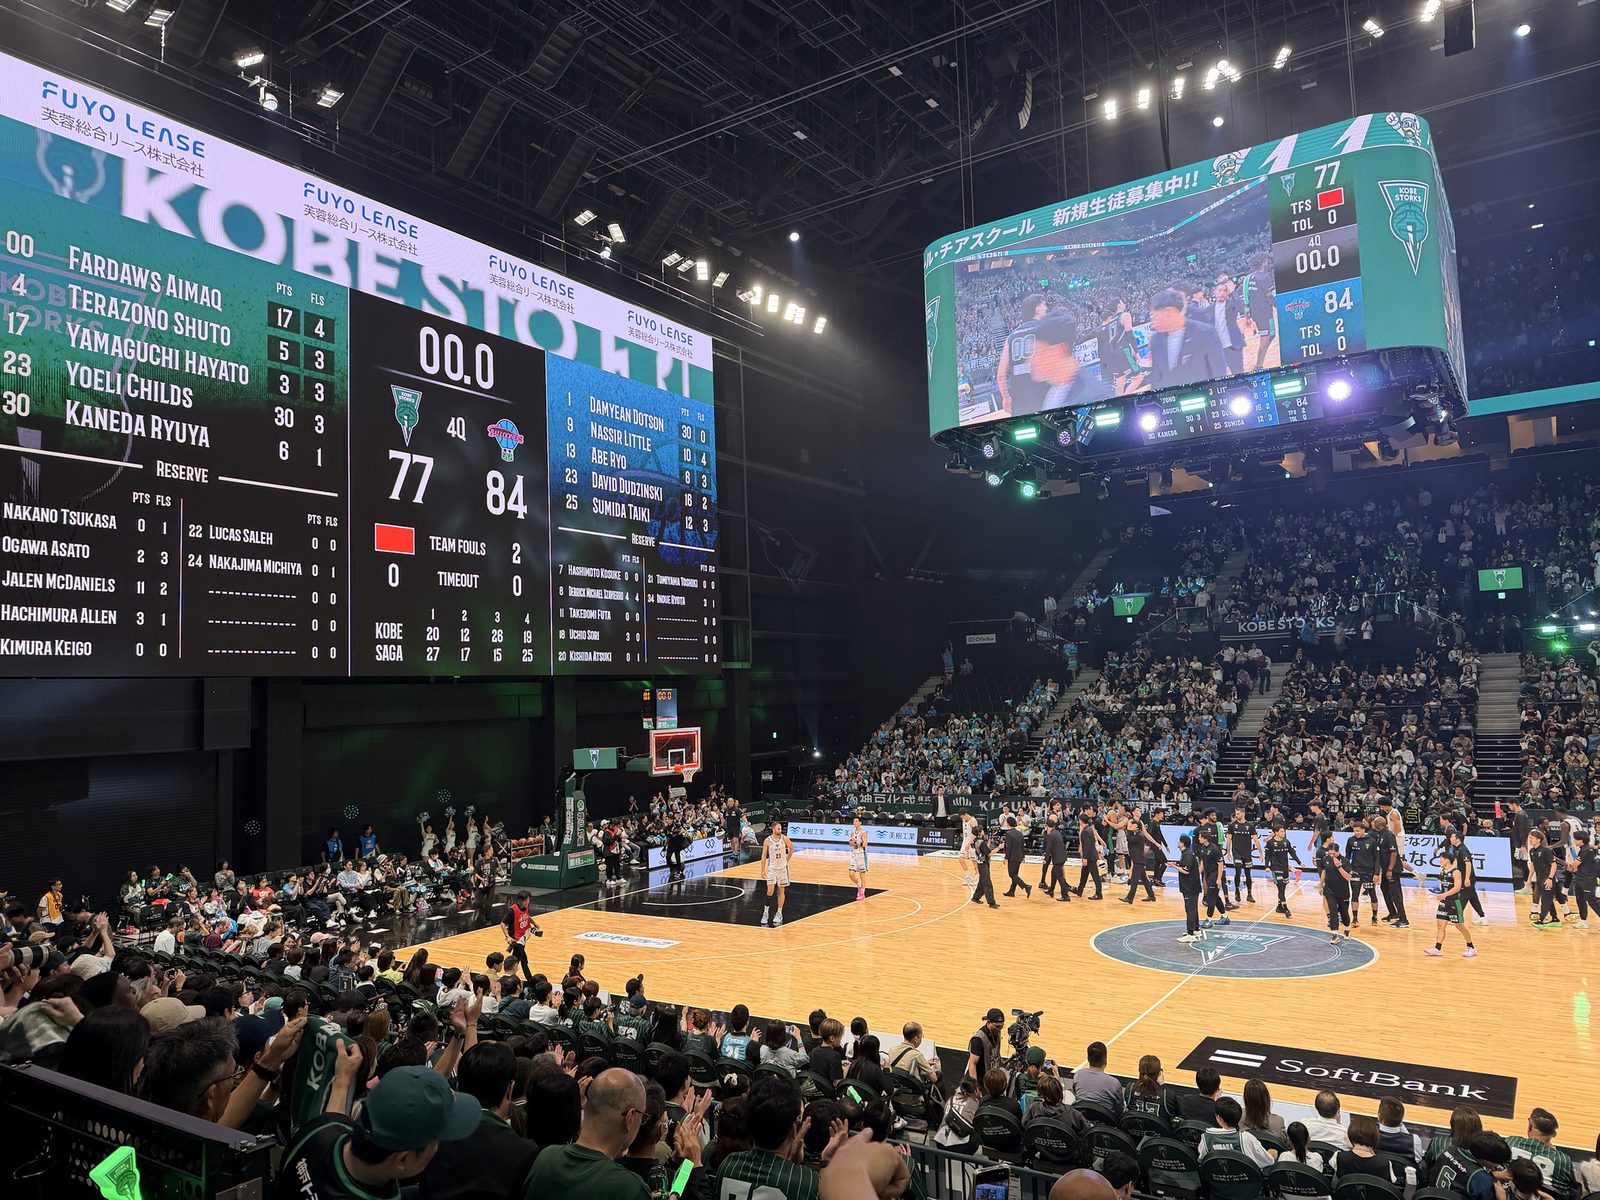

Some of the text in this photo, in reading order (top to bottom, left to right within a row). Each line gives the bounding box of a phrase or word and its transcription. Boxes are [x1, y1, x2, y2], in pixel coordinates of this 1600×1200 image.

[42, 81, 205, 158] FUYO LEASE
[41, 106, 205, 178] 芙蓉総合リース株式会社
[1314, 160, 1341, 189] 77
[304, 182, 418, 240] FUYO LEASE
[1052, 170, 1199, 227] 新規生徒募集中!!
[1290, 199, 1312, 216] TFS
[1394, 194, 1422, 202] STORKS
[303, 203, 418, 256] 芙蓉総合リース株式会社
[1292, 209, 1337, 233] TOL 0
[1308, 234, 1321, 248] 4Q
[1295, 245, 1340, 274] 00.0
[6, 230, 325, 338] 00 FARDAWS AIMAQ 17 4
[276, 282, 292, 297] PTS
[489, 255, 575, 299] FUYO LEASE
[310, 293, 325, 306] FLS
[489, 273, 576, 314] 芙蓉総合リース株式会社
[1324, 287, 1354, 314] 84
[12, 273, 324, 370] 4 TERAZONO SHUTO 5 3
[627, 310, 693, 346] FUYO LEASE
[1300, 318, 1344, 339] TFS 2
[7, 312, 324, 402] 17 YAMAGUCHI HAYATO 3 3
[419, 326, 494, 390] 00.0
[1301, 336, 1346, 358] TOL 0
[3, 350, 324, 434] 23 YOELI CHILDS 30 3
[3, 391, 289, 460] 30 KANEDA RYUYA 6
[446, 417, 467, 442] 4Q
[568, 392, 706, 443] 1 DAMYEAN DOTSON 30 0
[568, 417, 706, 466] 9 NASSIR LITTLE 10 4
[156, 460, 209, 483] RESERVE
[566, 443, 707, 488] 13 ABE RYO 6 3
[388, 450, 528, 519] 77 84
[565, 468, 577, 484] 23
[592, 471, 617, 492] DAVID
[619, 477, 663, 501] DUDZINSKI
[702, 496, 707, 510] 2
[132, 492, 171, 507] PTS FLS
[566, 494, 708, 532] 25 SUMIDA TAIKI 12 3
[3, 502, 146, 532] NAKANO TSUKASA 0
[189, 524, 273, 545] 22 LUCAS SALEH
[632, 533, 656, 547] RESERVE
[2, 536, 168, 565] OGAWA ASATO 2 3
[429, 536, 521, 564] TEAM FOULS 2
[188, 554, 302, 576] 24 NAKAJIMA MICHIYA
[2, 570, 43, 589] JALEN
[137, 580, 145, 594] 11
[160, 582, 168, 595] 2
[388, 563, 522, 597] 0 TIMEOUT 0
[1, 604, 144, 626] HACHIMURA ALLEN 3
[431, 608, 530, 624] 1 2 3 4
[1238, 620, 1275, 632] KOBE
[0, 638, 167, 657] KIMURA KEIGO 0 0
[375, 622, 532, 644] KOBE 20 12 26 19
[375, 645, 533, 663] SAGA 27 17 15 25
[1274, 1059, 1488, 1100] SoftBank
